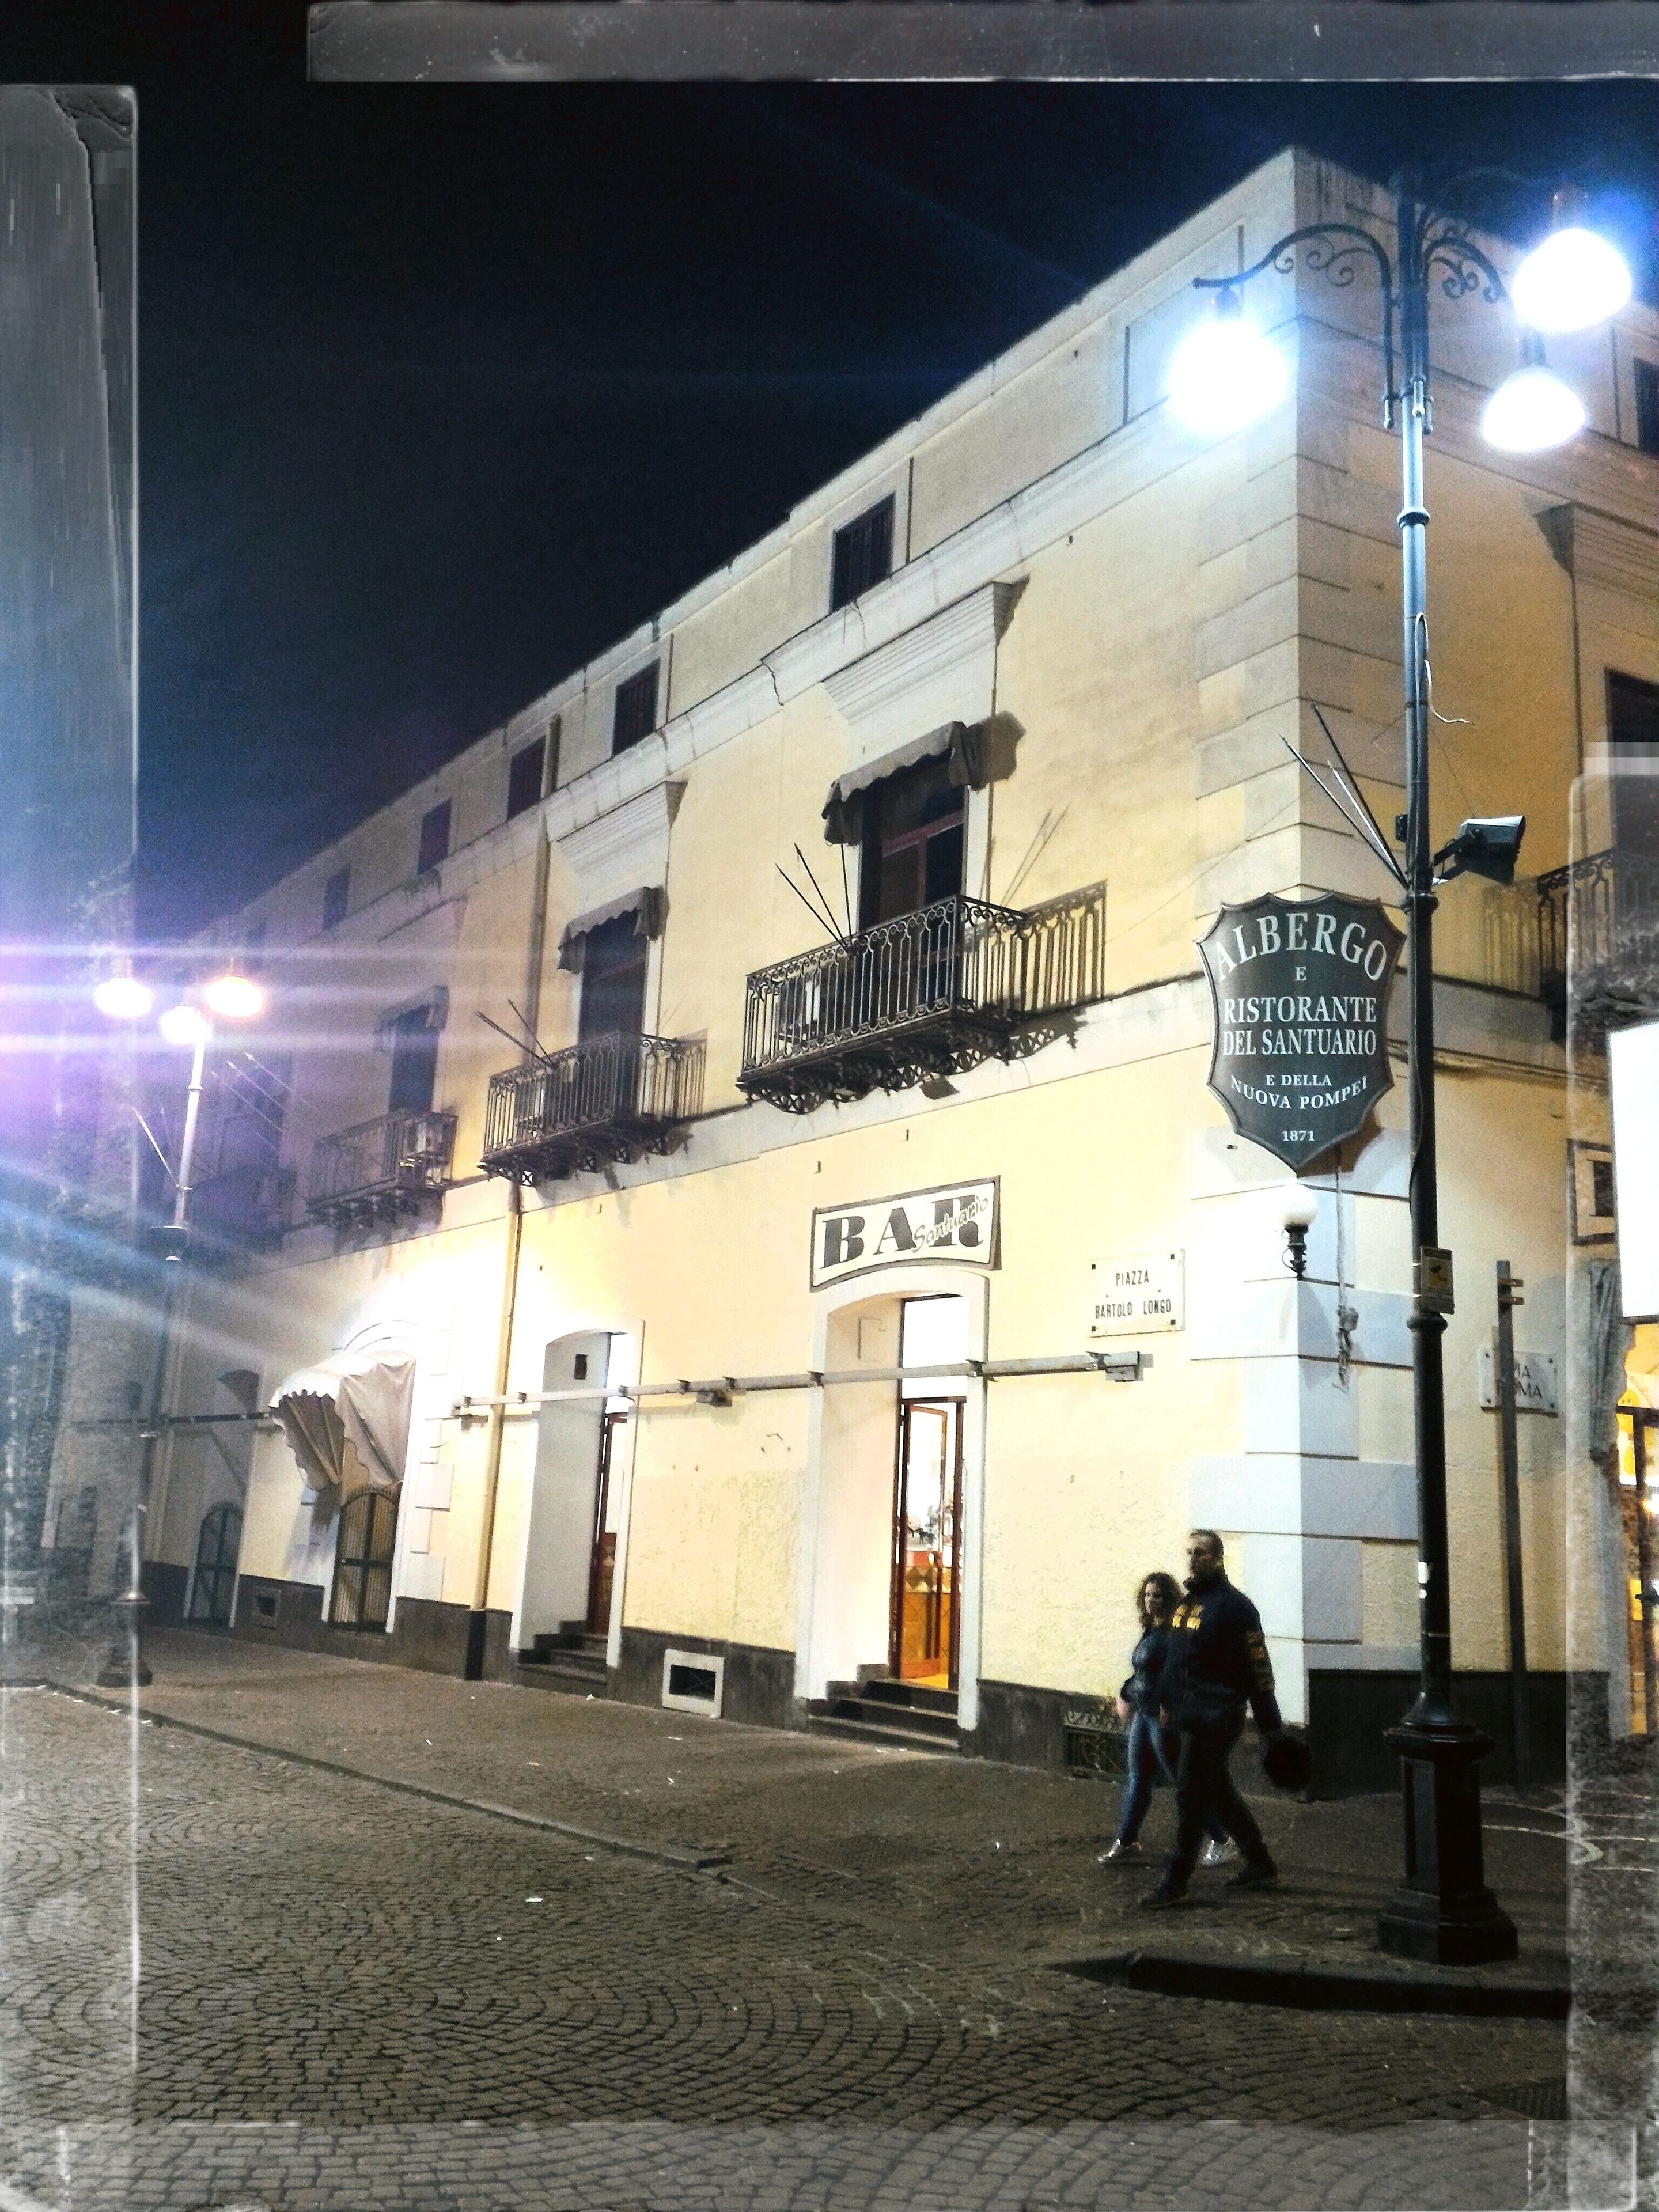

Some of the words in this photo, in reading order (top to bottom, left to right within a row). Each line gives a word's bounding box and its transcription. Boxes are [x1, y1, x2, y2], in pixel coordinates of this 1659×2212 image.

[1215, 912, 1387, 981] ALBERGO
[1295, 967, 1306, 981] E
[1223, 996, 1377, 1024] RISTORANTE
[1222, 1030, 1256, 1056] DEL
[1262, 1028, 1376, 1055] SANTUARIO
[1231, 1075, 1291, 1109] NUOVA
[1300, 1075, 1368, 1109] POMPEI
[1266, 1075, 1275, 1086] E
[1281, 1075, 1332, 1086] DELLA
[1282, 1130, 1315, 1142] 1871
[820, 1195, 984, 1270] BAR
[1116, 1270, 1150, 1286] PIAZZA
[1095, 1302, 1132, 1319] BARTOLO
[1143, 1298, 1171, 1315] LONGO
